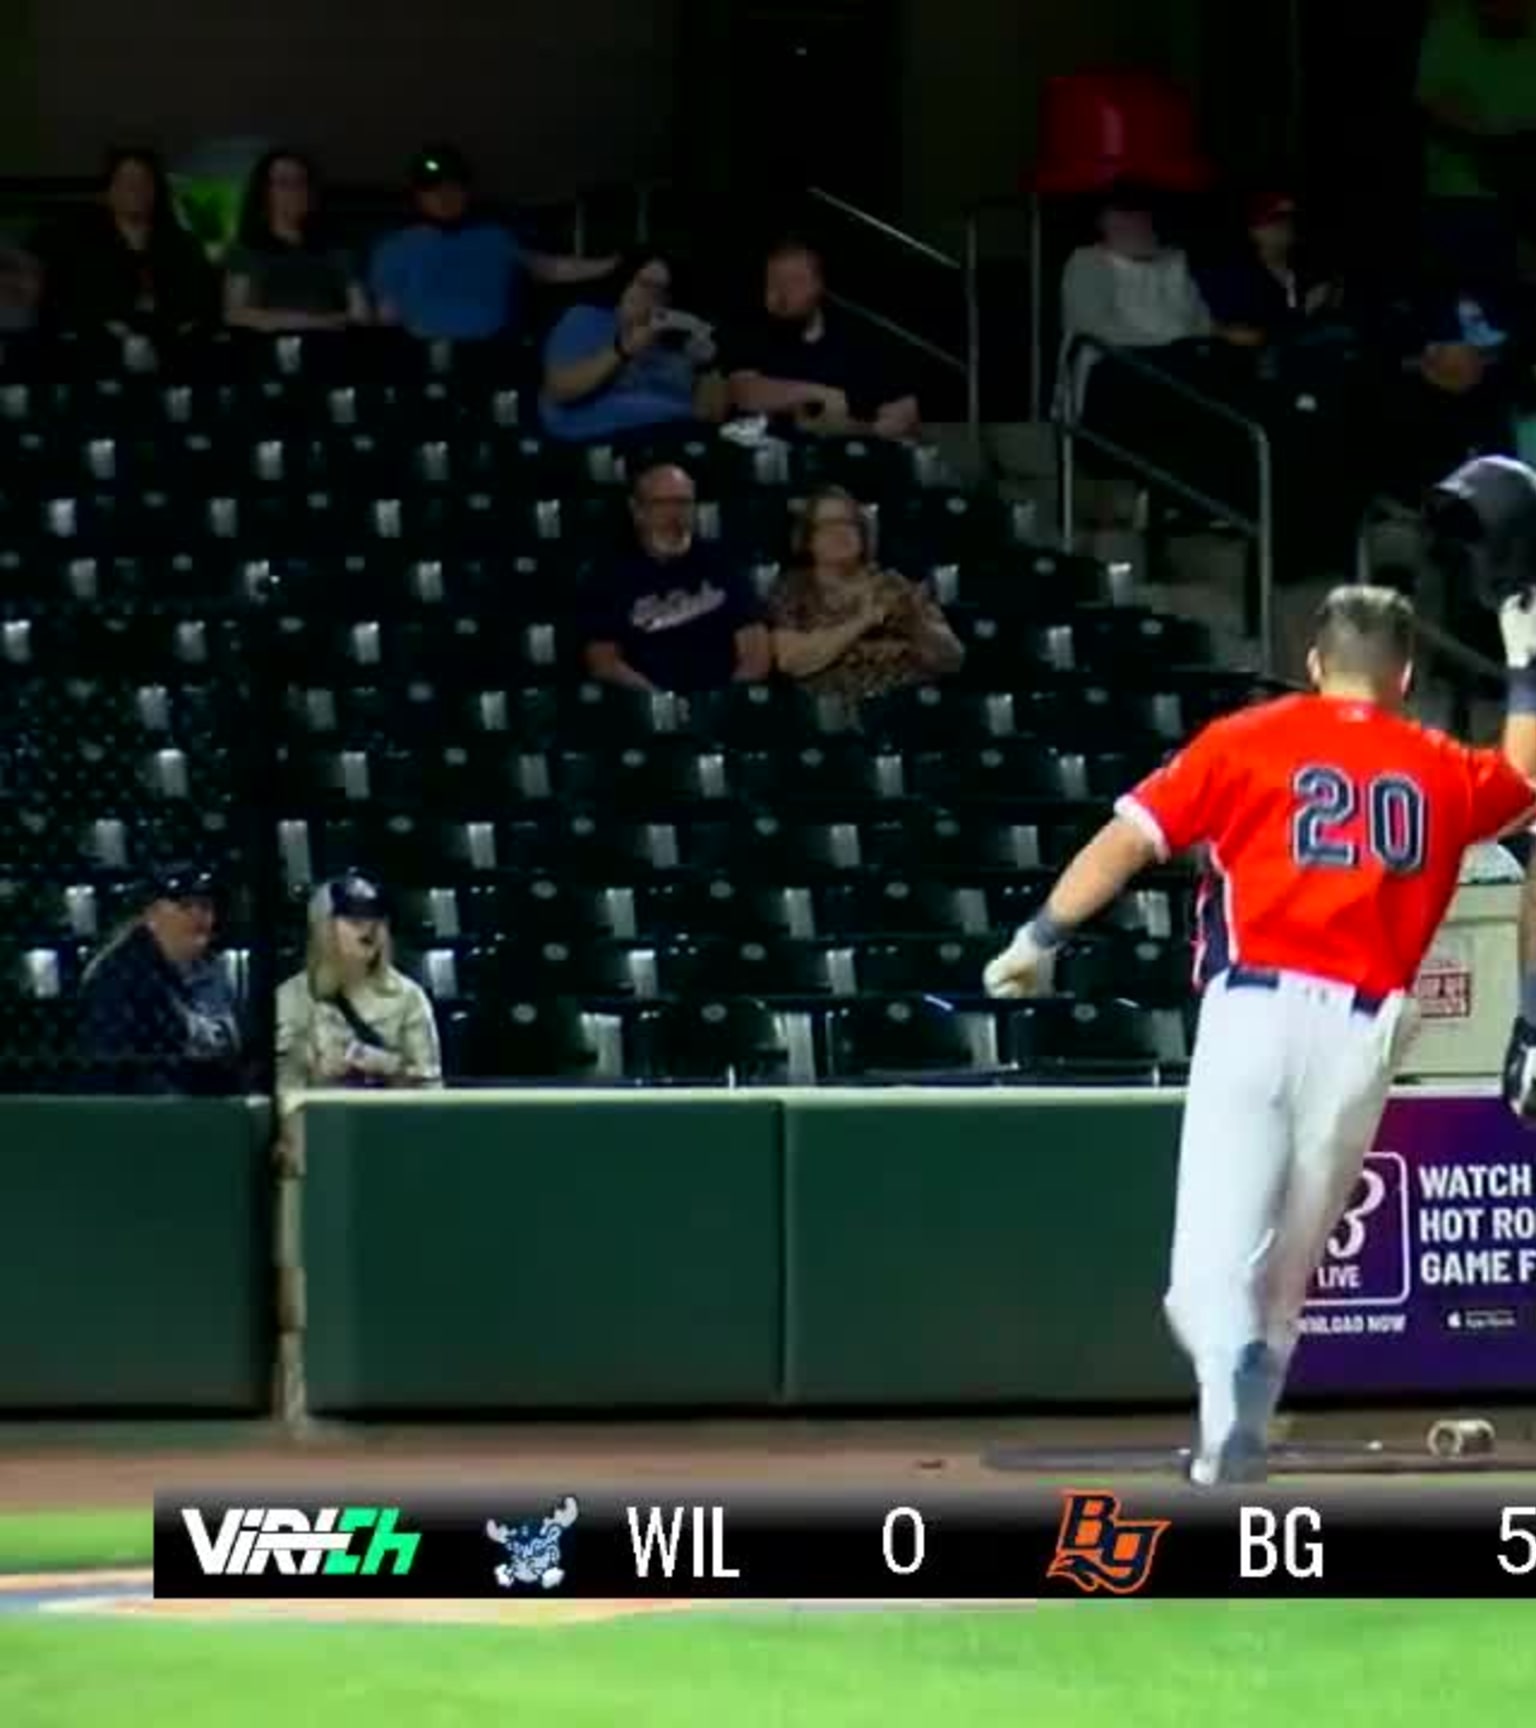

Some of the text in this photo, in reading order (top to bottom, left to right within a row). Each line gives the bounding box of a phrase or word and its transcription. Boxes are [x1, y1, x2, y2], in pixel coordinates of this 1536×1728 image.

[1293, 762, 1426, 875] 20
[1418, 1163, 1531, 1199] WATCH
[1419, 1208, 1485, 1243] HOT
[1317, 1265, 1361, 1289] LIVE
[1420, 1252, 1512, 1285] GAME
[1367, 1313, 1406, 1333] NOW
